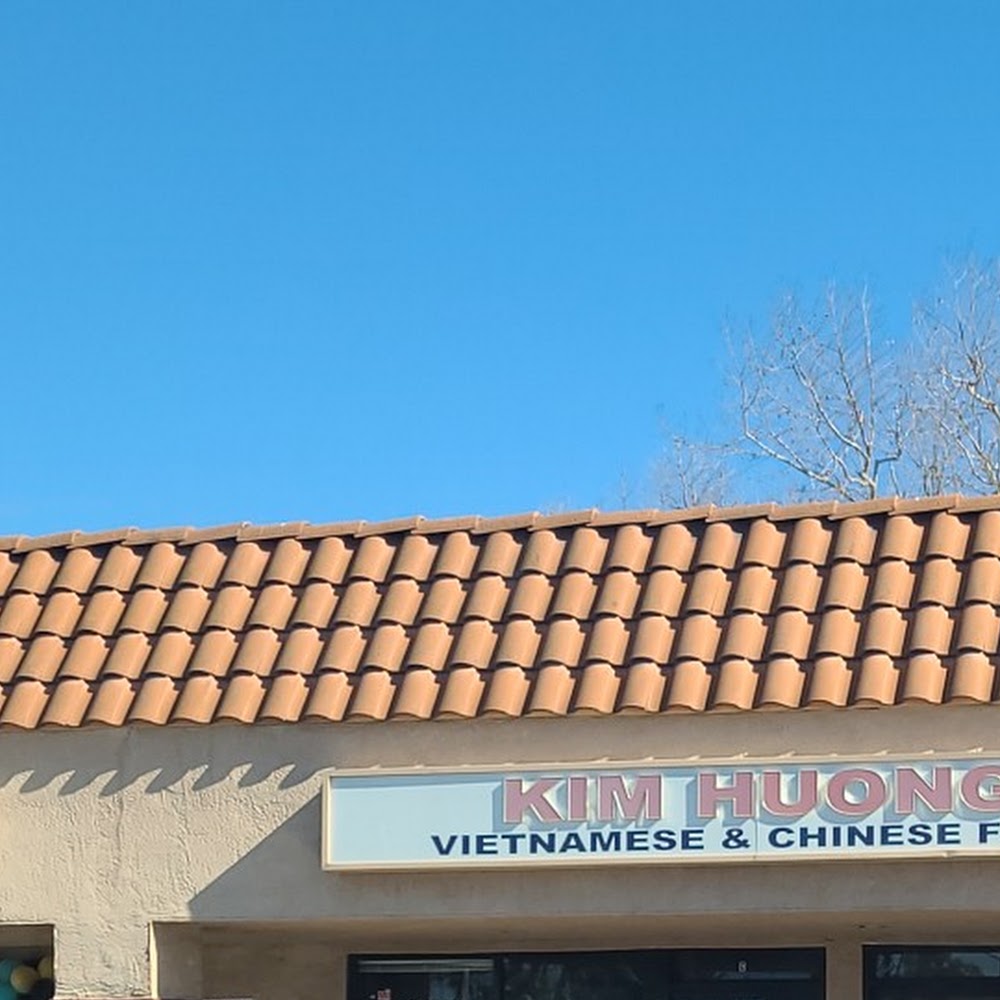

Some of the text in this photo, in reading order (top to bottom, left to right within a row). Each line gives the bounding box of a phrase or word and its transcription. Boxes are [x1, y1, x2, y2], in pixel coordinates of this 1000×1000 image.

[503, 774, 663, 824] KIM
[431, 829, 705, 856] VIETNAMESE
[721, 828, 751, 850] &
[768, 823, 961, 849] CHINESE
